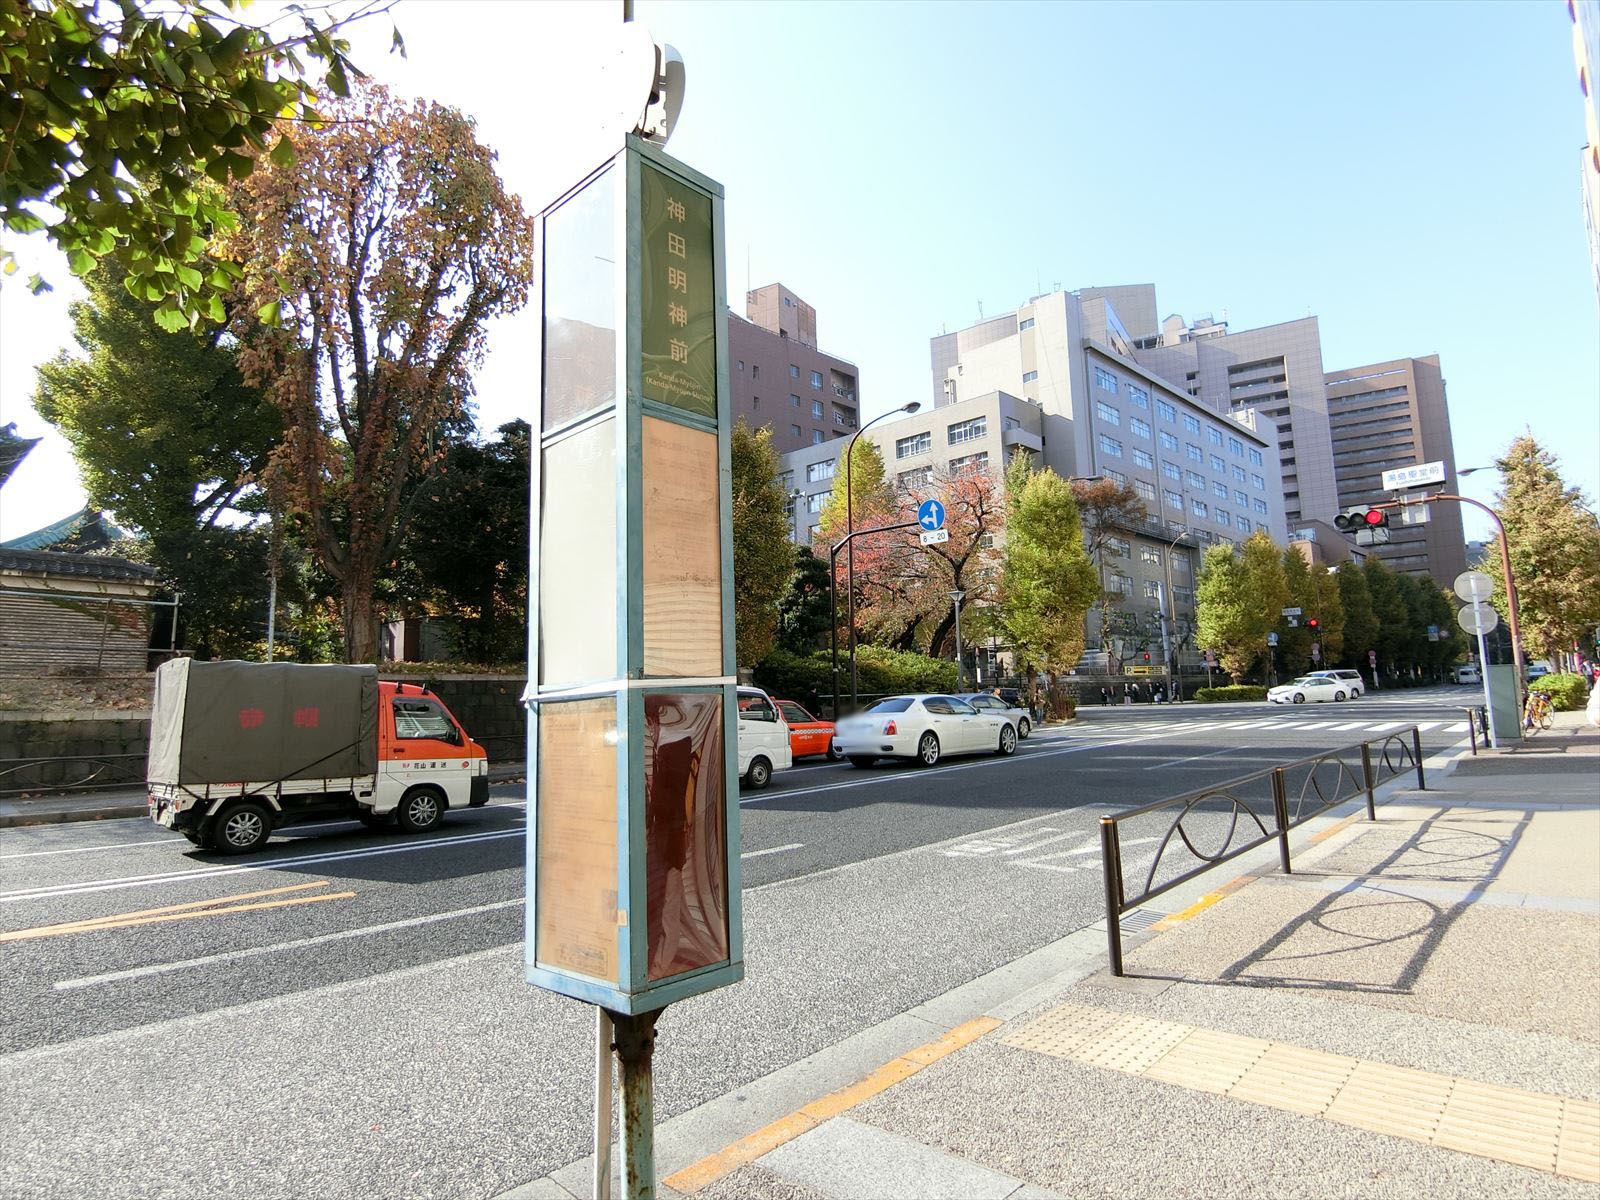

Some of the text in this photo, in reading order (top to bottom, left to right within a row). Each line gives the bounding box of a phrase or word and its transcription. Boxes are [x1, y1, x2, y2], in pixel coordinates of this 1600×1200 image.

[667, 197, 689, 364] 神田明神前
